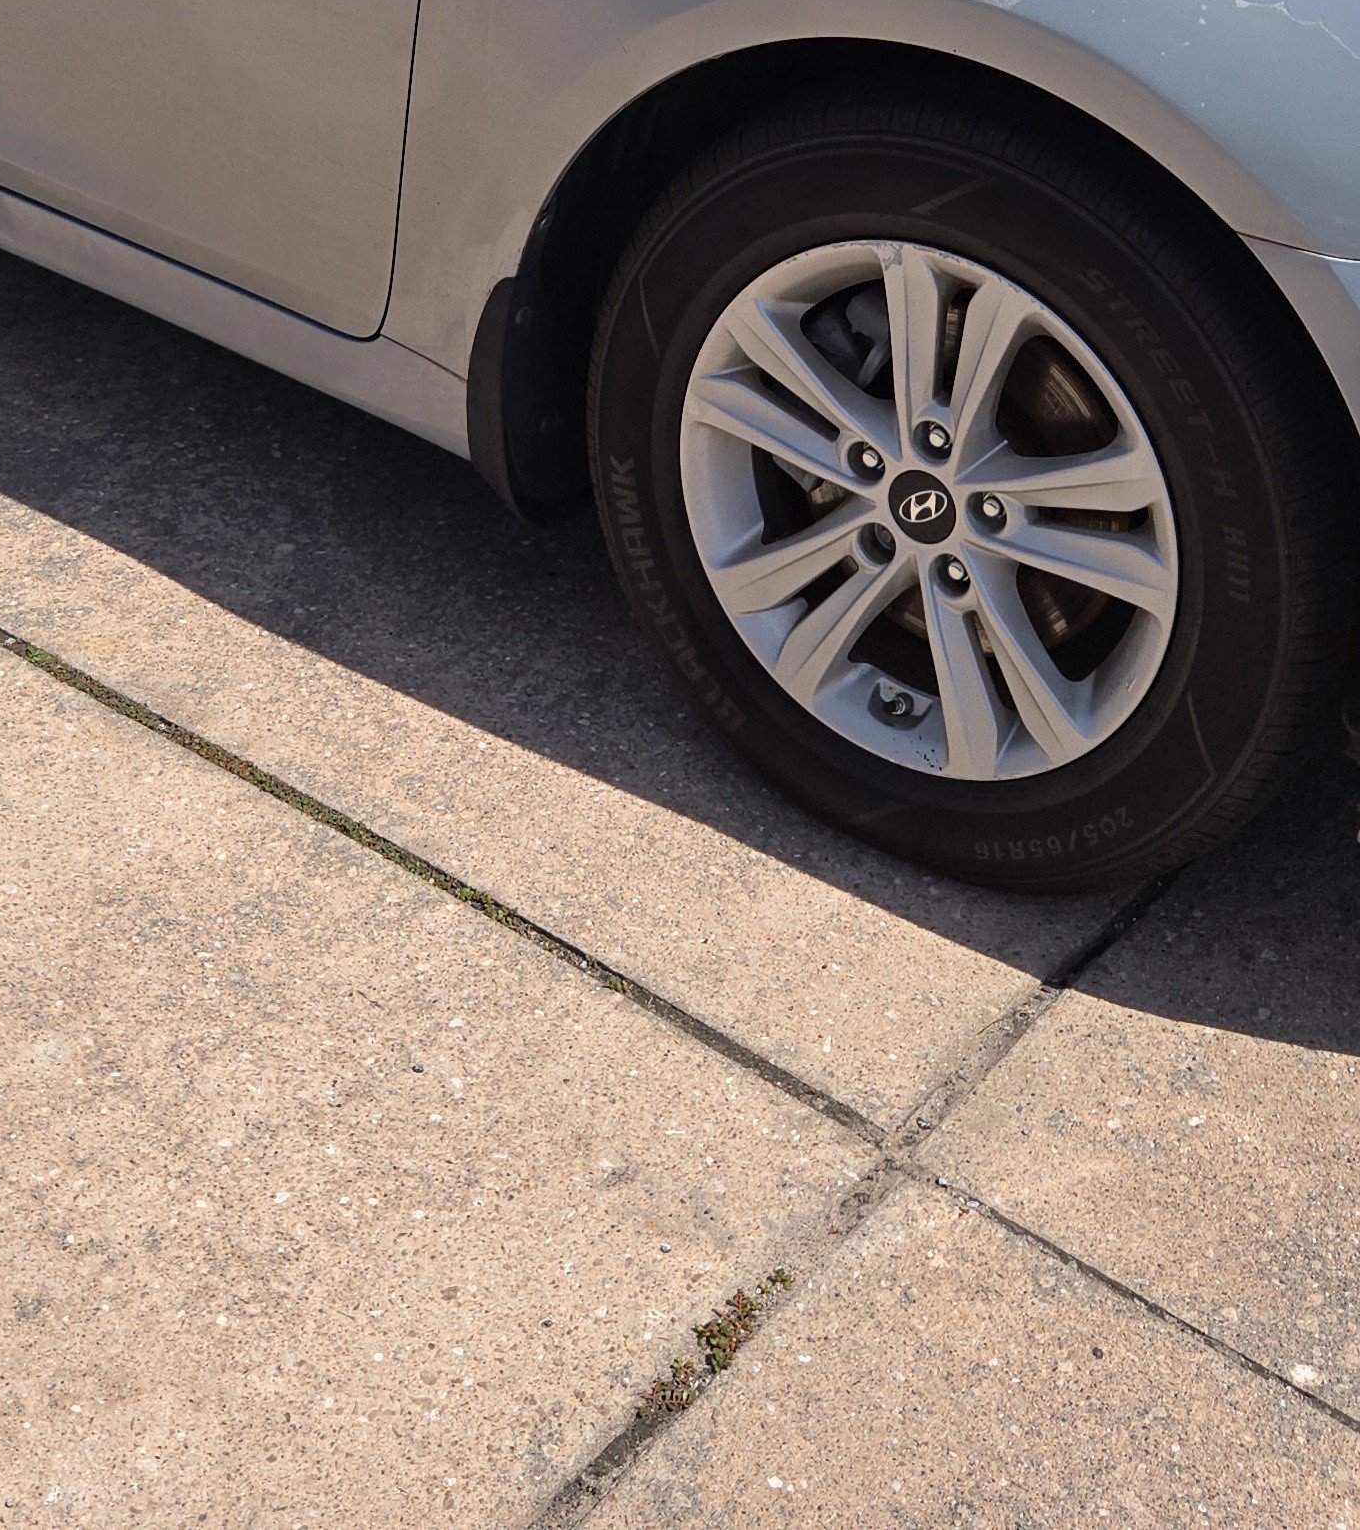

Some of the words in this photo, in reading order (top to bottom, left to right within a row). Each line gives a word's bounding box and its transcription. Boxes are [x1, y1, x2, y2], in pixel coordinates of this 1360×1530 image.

[1077, 269, 1239, 499] STREET-H
[608, 453, 747, 733] BLACKHAWK
[974, 805, 1134, 861] 205/65R16
